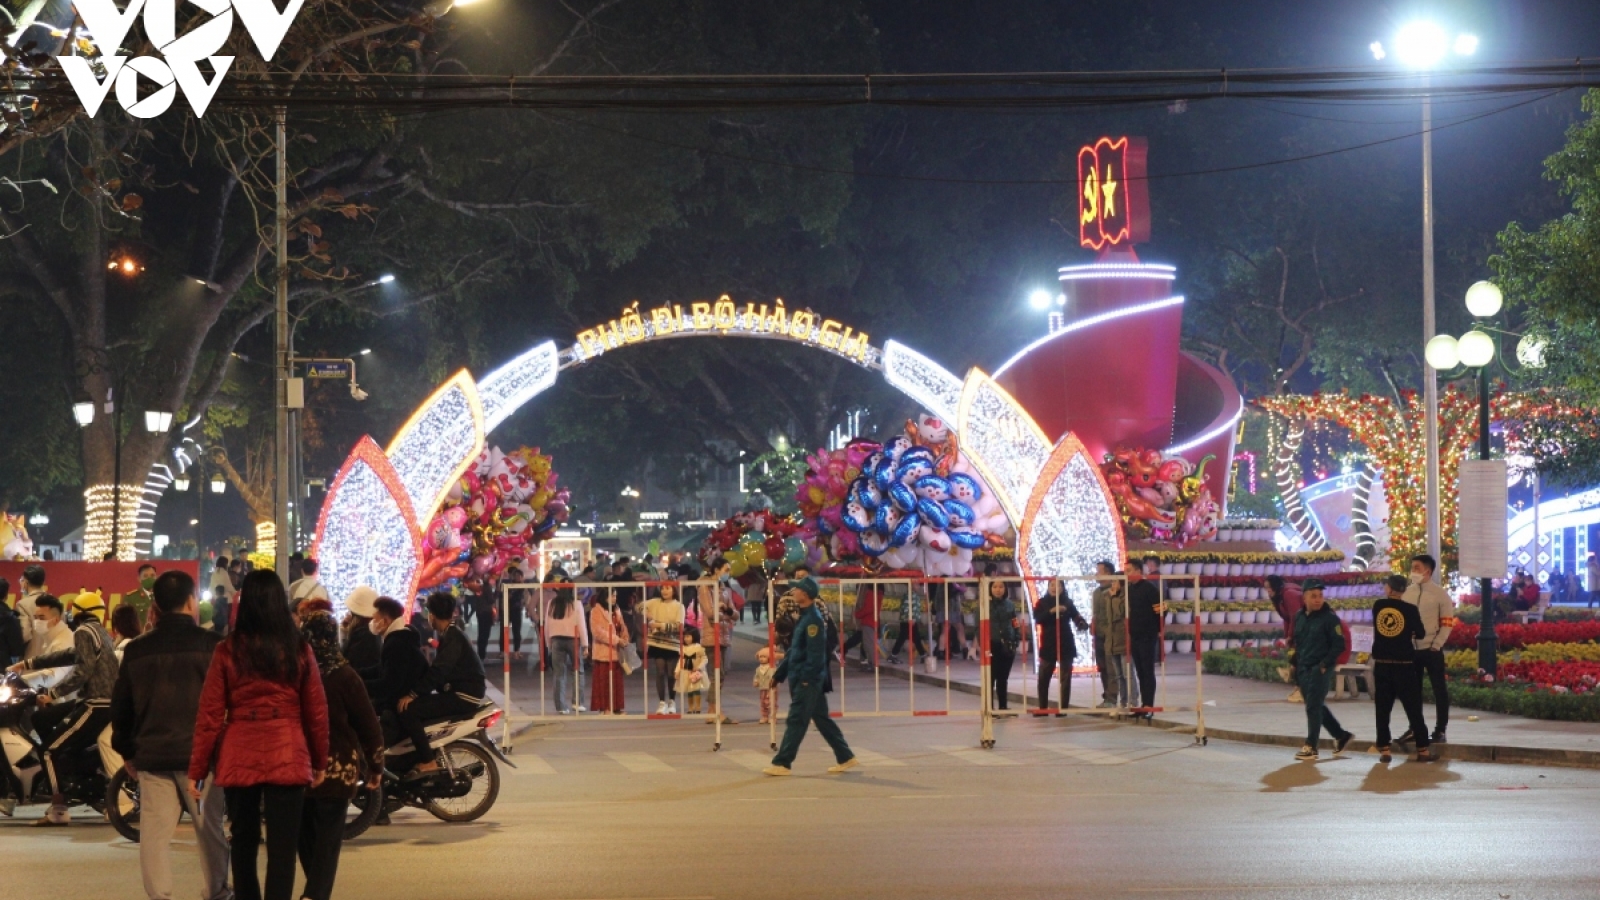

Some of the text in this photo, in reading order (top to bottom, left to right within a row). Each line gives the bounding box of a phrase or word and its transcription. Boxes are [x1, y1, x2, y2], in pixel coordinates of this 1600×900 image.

[576, 294, 869, 361] PHỐ ĐI BỘ HÀO GIA
